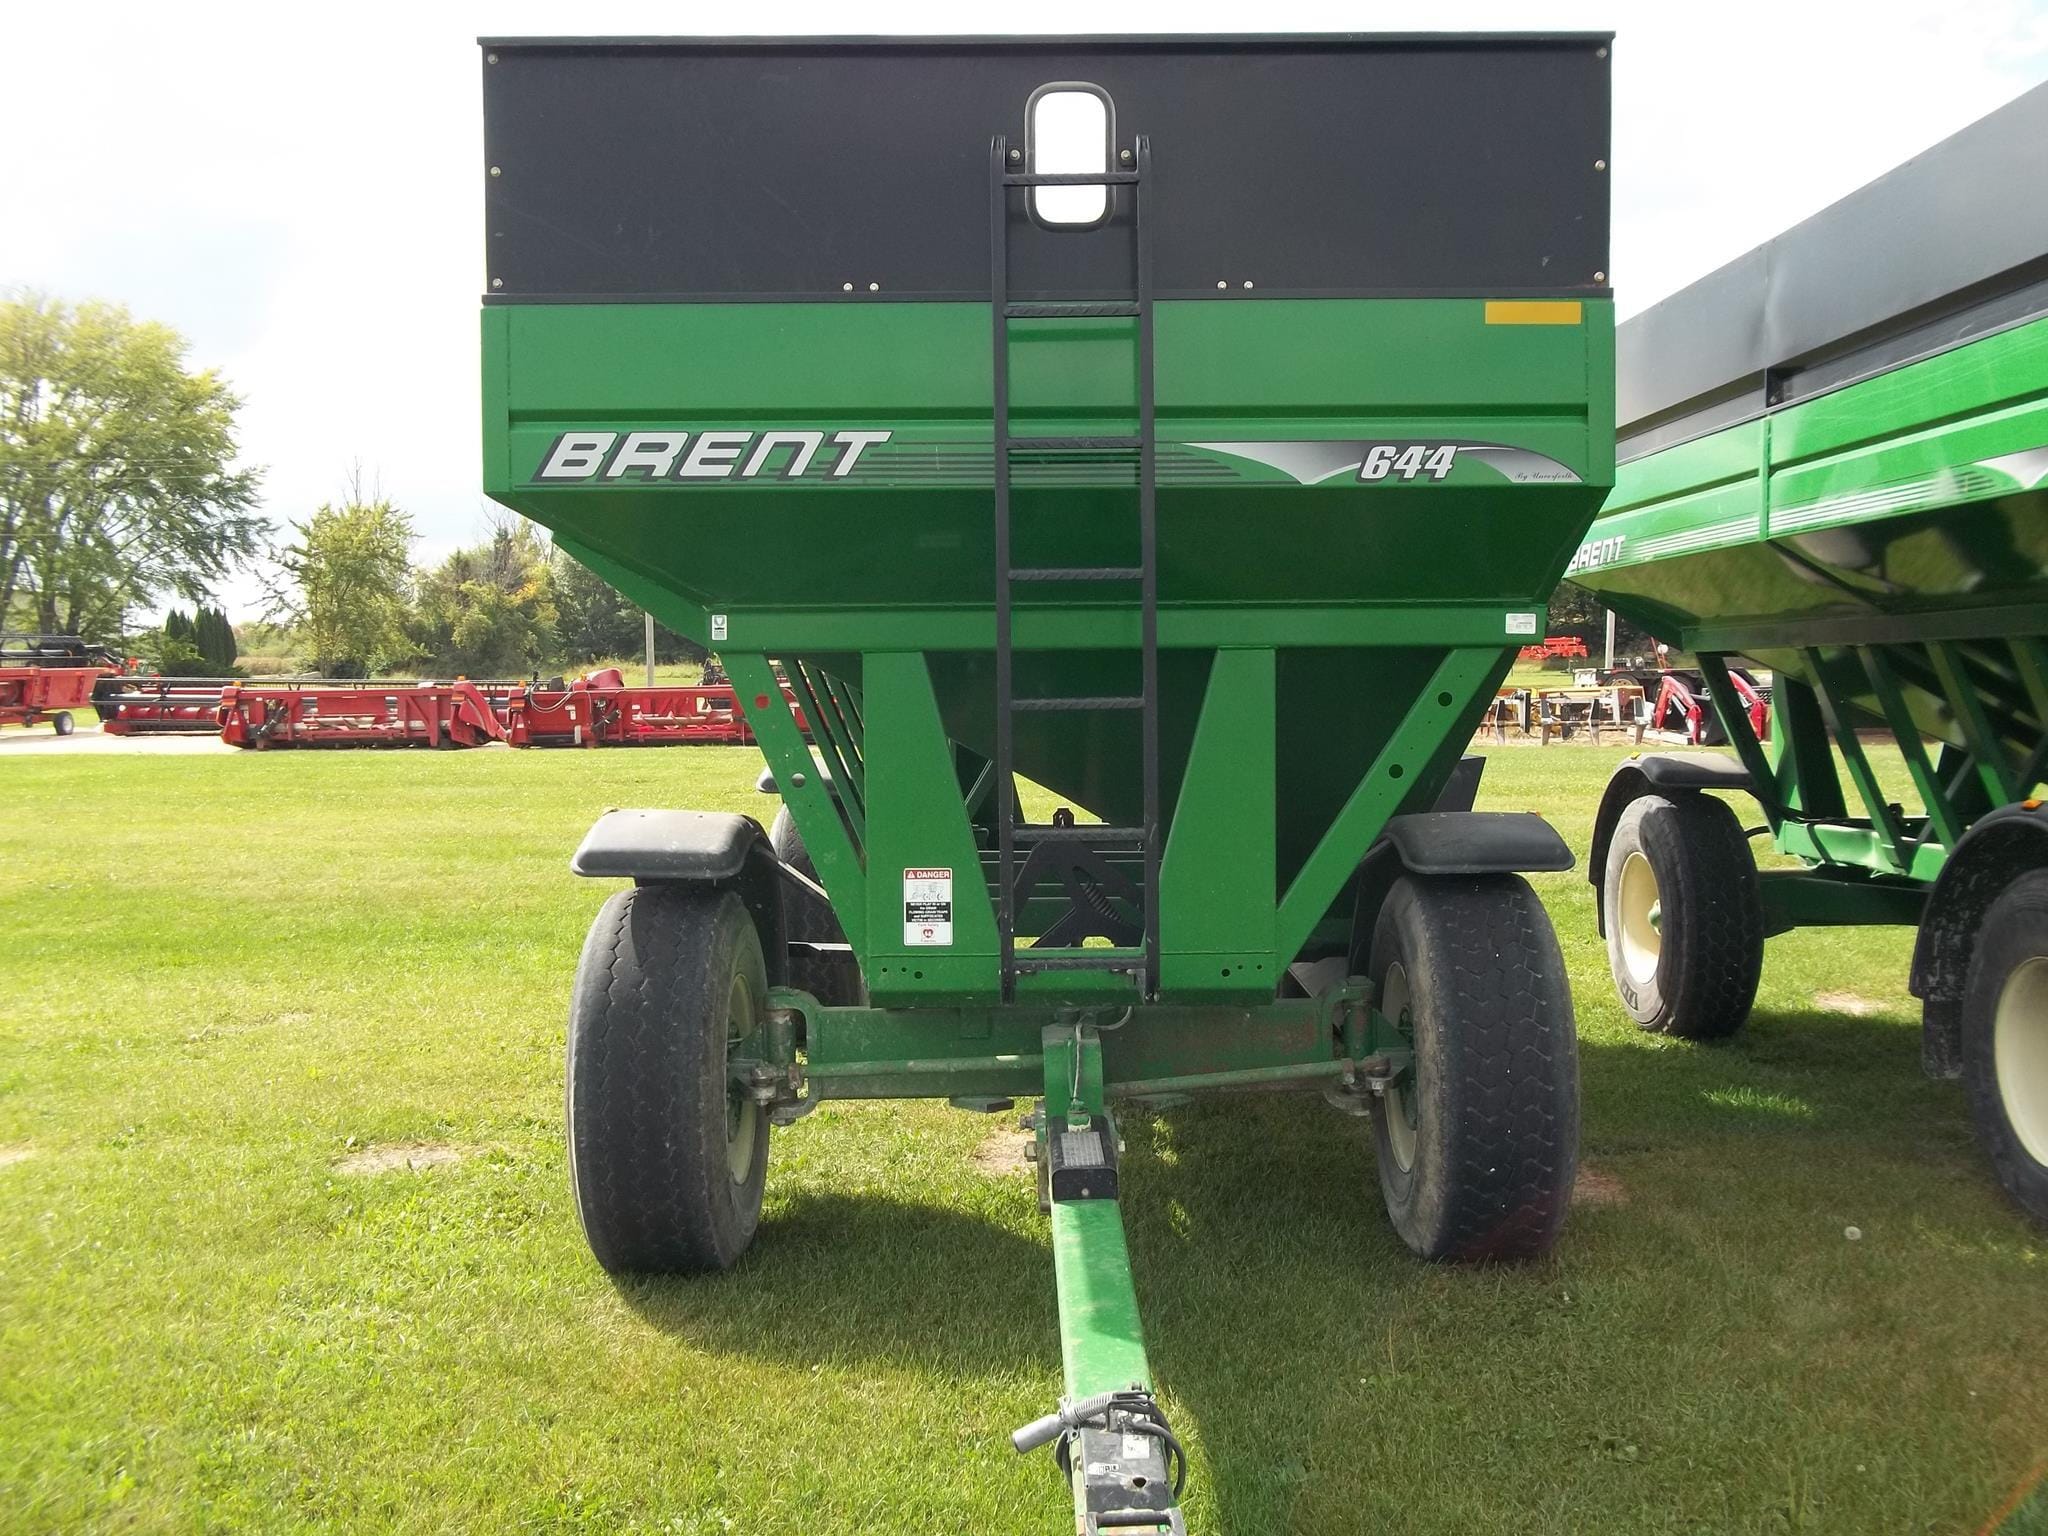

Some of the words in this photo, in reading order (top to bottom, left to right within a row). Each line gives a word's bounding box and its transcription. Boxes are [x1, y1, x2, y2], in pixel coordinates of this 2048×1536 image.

[535, 431, 893, 480] BRENT
[1359, 445, 1457, 480] 644
[916, 870, 950, 879] DANGER
